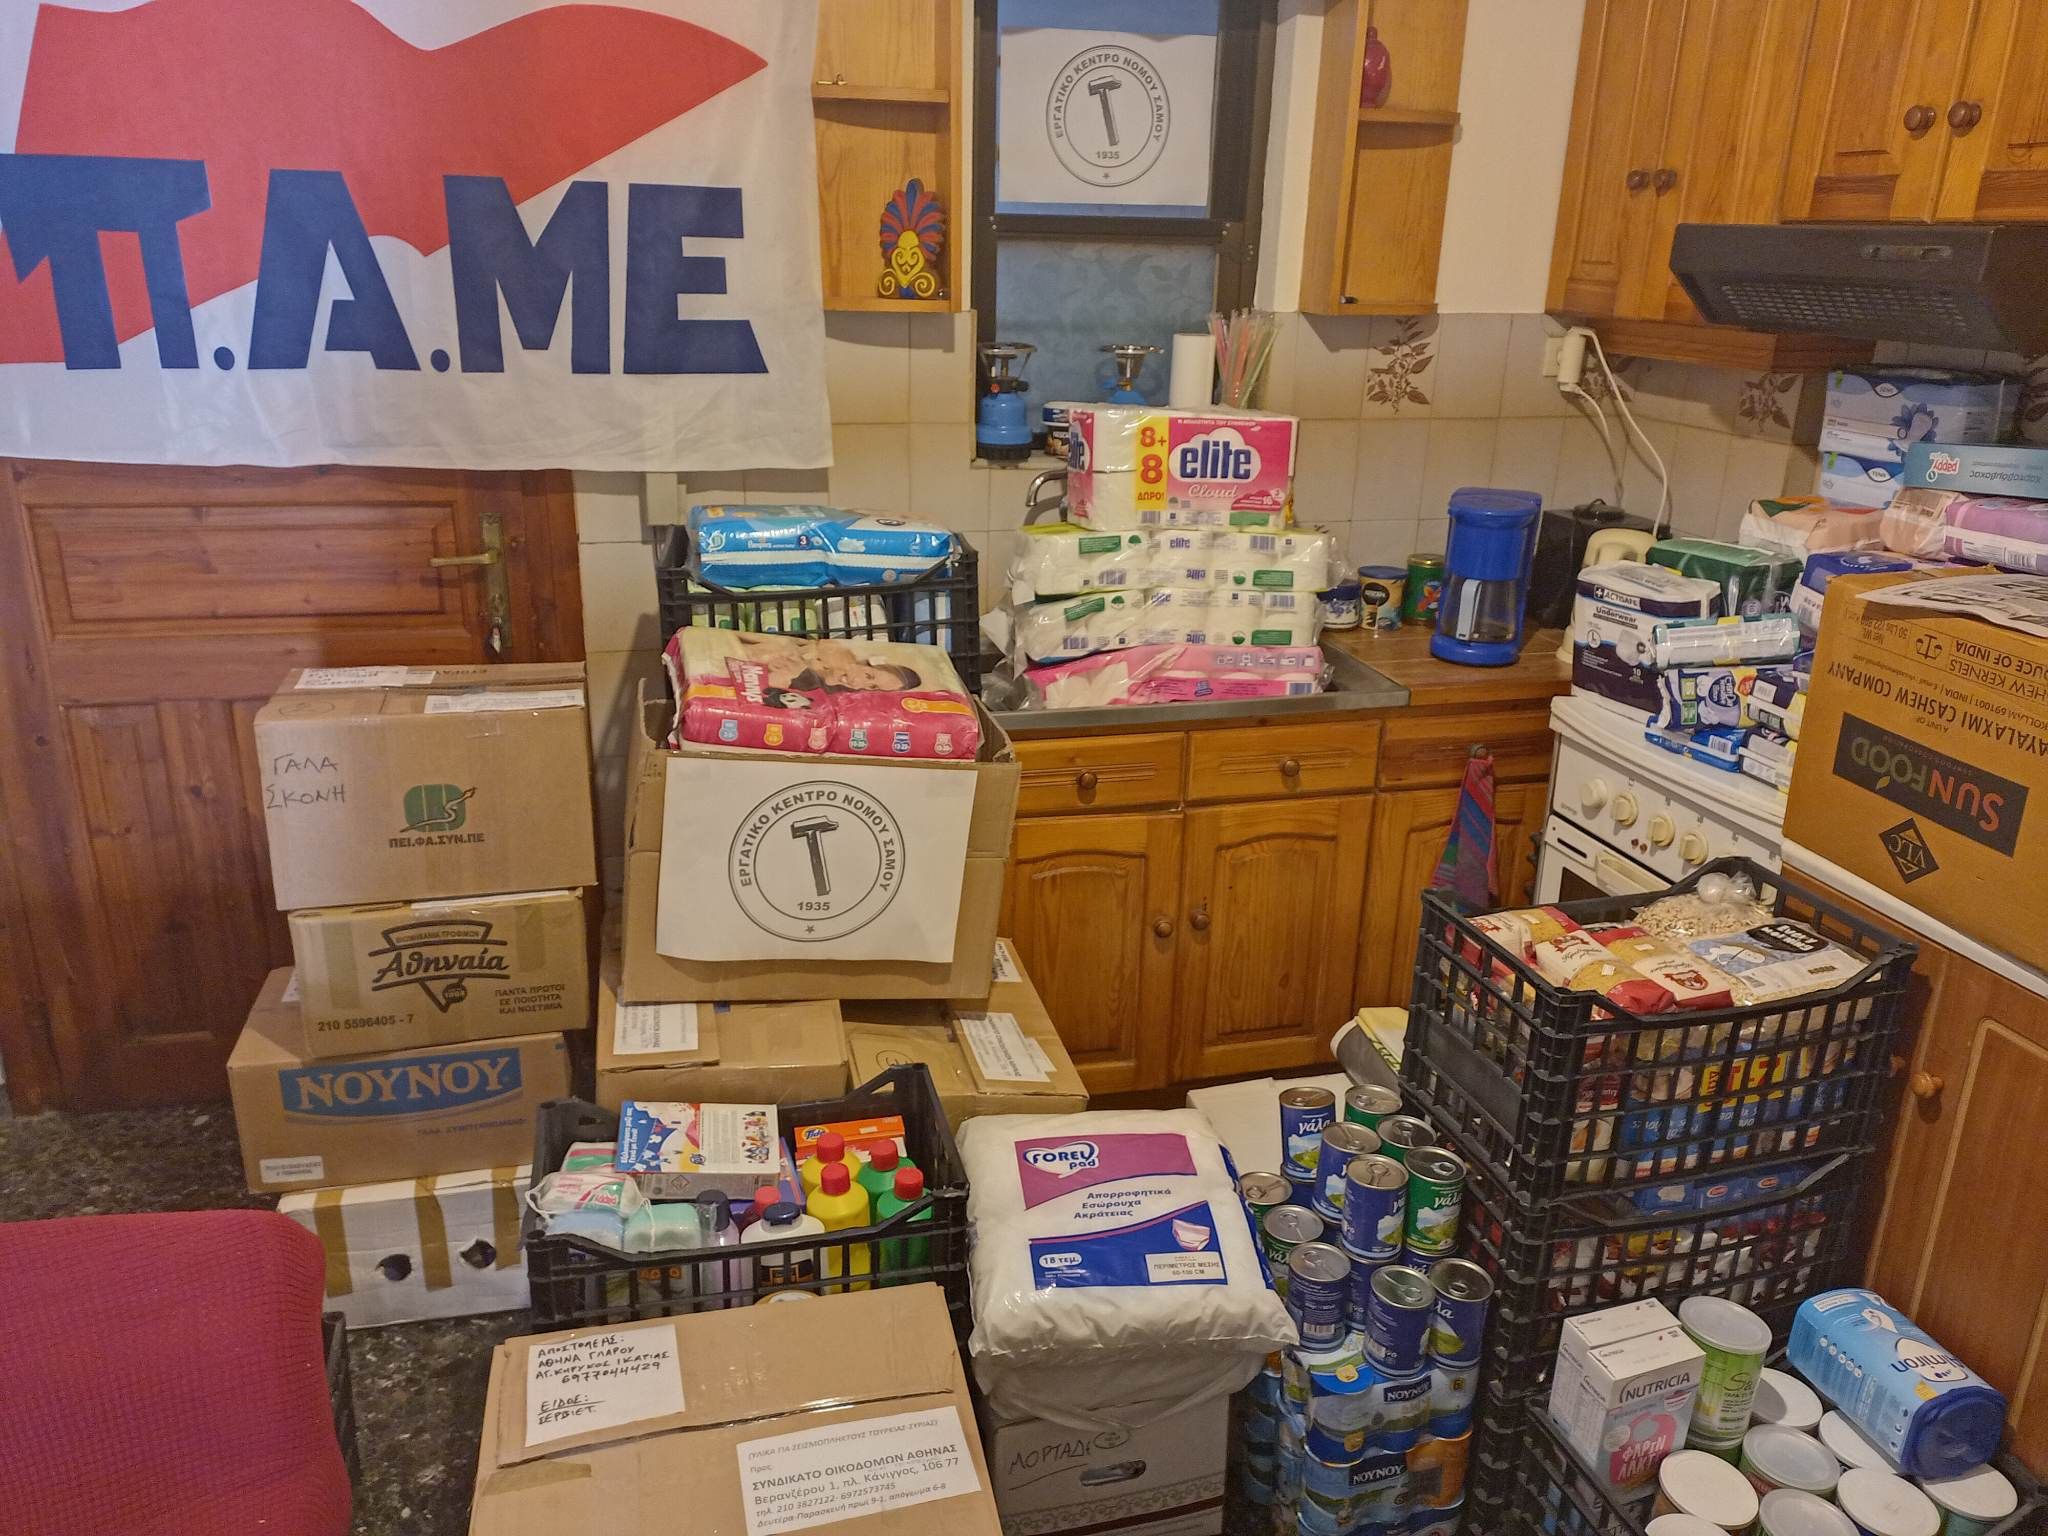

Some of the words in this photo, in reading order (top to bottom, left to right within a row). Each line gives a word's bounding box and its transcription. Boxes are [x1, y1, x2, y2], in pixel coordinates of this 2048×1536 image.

[1053, 74, 1074, 138] ΕΡΓΑΤΙΚΟ
[1073, 53, 1120, 76] ΚΕΝΤΡΟ
[1122, 56, 1158, 92] ΝΟΜΟΥ
[1152, 95, 1164, 142] ΣΑΜΟΥ
[1096, 151, 1120, 160] 1935
[1140, 426, 1168, 448] 8+
[1140, 454, 1164, 484] 8
[1180, 439, 1251, 480] elite
[1137, 490, 1165, 501] ΔΩΡΟ!
[1188, 484, 1239, 500] Cloud
[799, 536, 808, 544] 3
[1170, 537, 1190, 550] elite
[1594, 606, 1638, 625] Underwear
[1955, 640, 1992, 664] INDIA
[1994, 652, 2012, 672] OF
[1828, 660, 1893, 697] COMPANY
[1950, 658, 2006, 688] KERNELS
[1894, 686, 1957, 723] CASHEW
[274, 752, 338, 775] ΓΑΛΑ
[1850, 736, 2004, 832] SUNFOOD
[265, 784, 346, 810] ΣΚΟΝΗ
[739, 813, 770, 888] ΕΡΓΑΤΙΚΟ
[770, 790, 838, 816] ΚΕΝΤΡΟ
[842, 794, 890, 836] ΝΟΜΟΥ
[878, 838, 896, 892] ΣΑΜΟΥ
[797, 902, 831, 912] 1935
[371, 947, 510, 984] Αθηναία
[318, 1019, 340, 1032] 210
[406, 1014, 415, 1025] 7
[1069, 1159, 1096, 1170] pad
[1082, 1198, 1141, 1210] Εσώρουχα
[1087, 1188, 1172, 1200] Απορροφητικά
[1073, 1209, 1134, 1220] Ακράτειας
[1043, 1256, 1056, 1266] 18
[538, 1354, 582, 1369] ΑΘΗΝΑ
[588, 1346, 636, 1360] ΓΛΑΡΟΥ
[1624, 1372, 1690, 1401] NUTRICIA
[752, 1470, 822, 1490] ΣΥΝΔΙΚΑΤΟ
[825, 1453, 904, 1477] ΟΙΚΟΔΟΜΩΝ
[907, 1444, 958, 1461] ΑΘΗΝΑΣ
[754, 1484, 826, 1506] Βερανζέρου
[922, 1461, 944, 1472] 106
[945, 1456, 960, 1468] 77
[776, 1503, 794, 1514] 210
